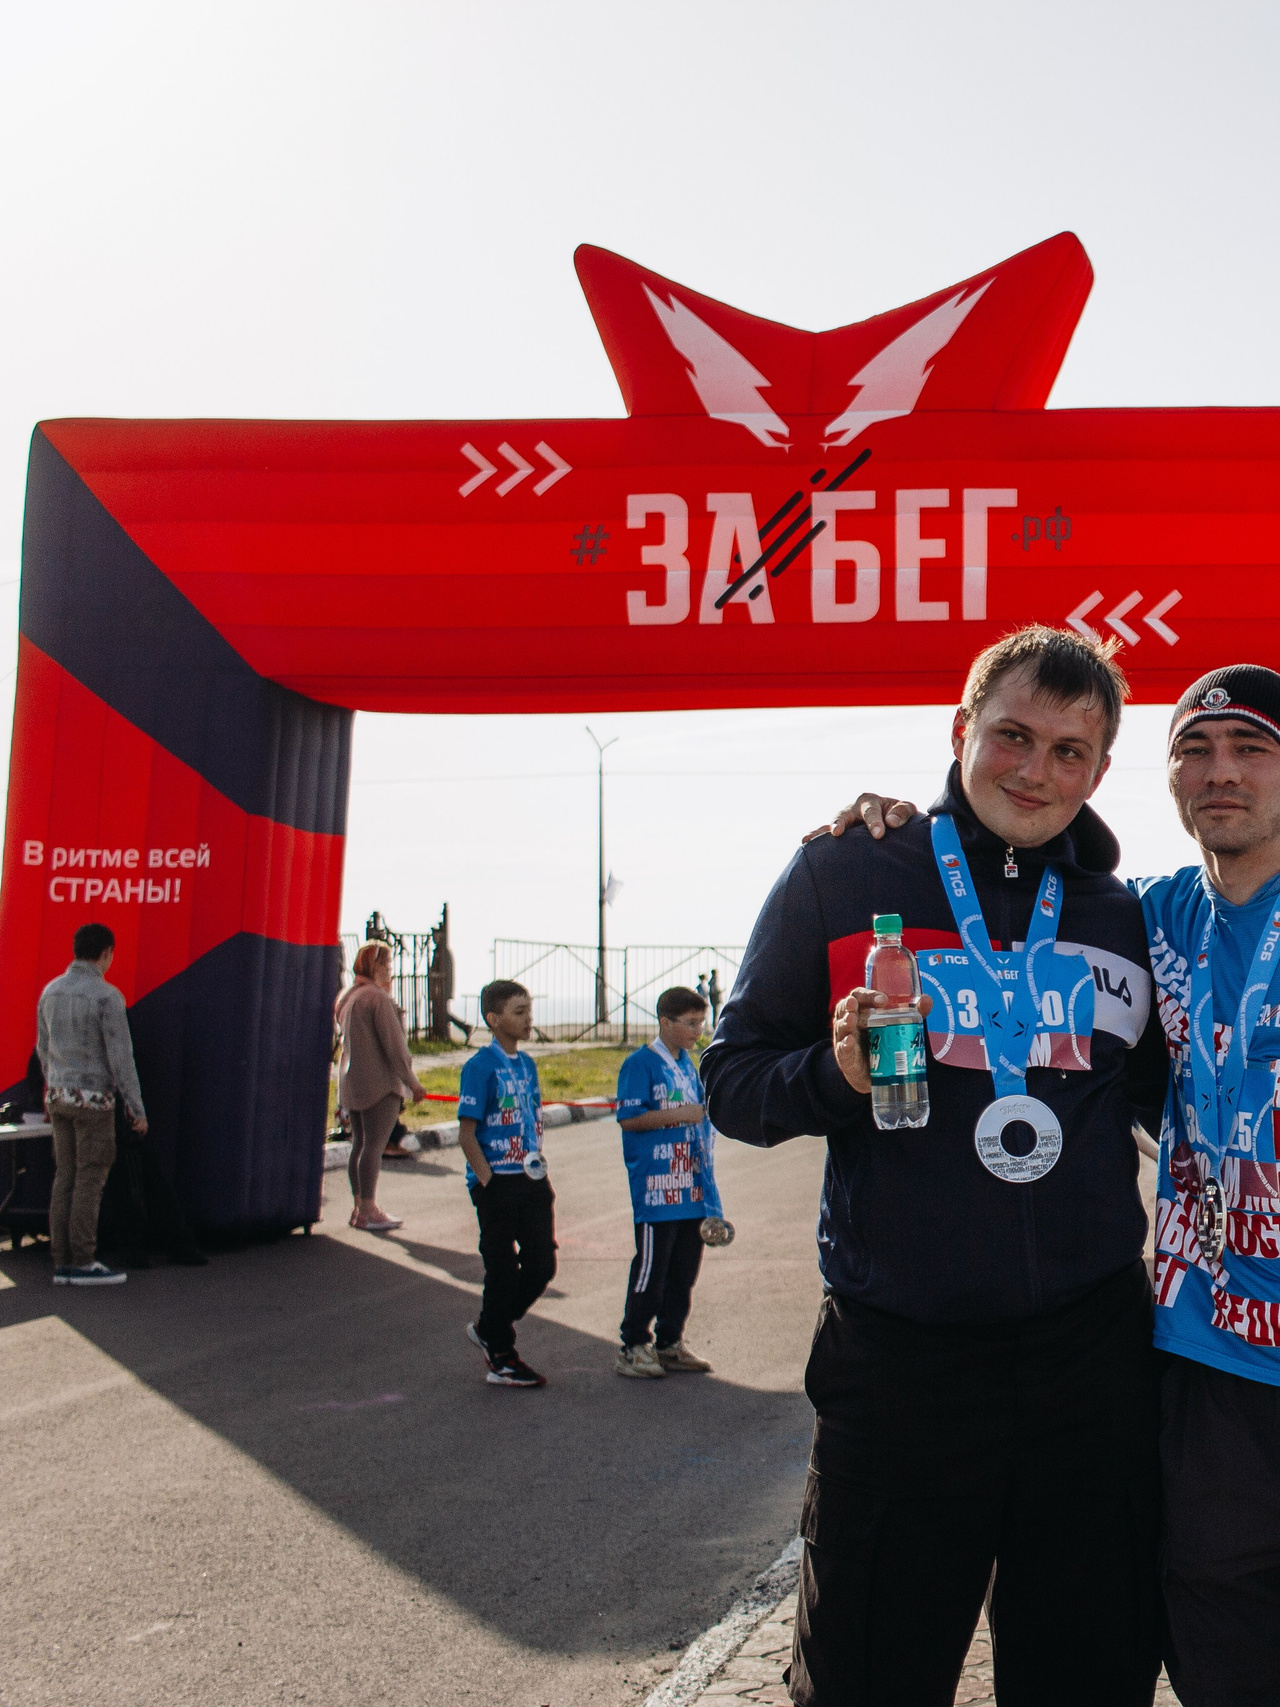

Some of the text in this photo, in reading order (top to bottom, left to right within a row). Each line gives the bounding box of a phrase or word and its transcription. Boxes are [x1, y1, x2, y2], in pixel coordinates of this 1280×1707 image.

[23, 840, 211, 870] В ритме всей
[49, 876, 181, 904] СТРАНЫ!
[948, 870, 967, 898] ПСБ
[1044, 874, 1058, 901] ПСБ
[1260, 930, 1280, 961] ПСБ
[945, 955, 969, 965] ПСБ
